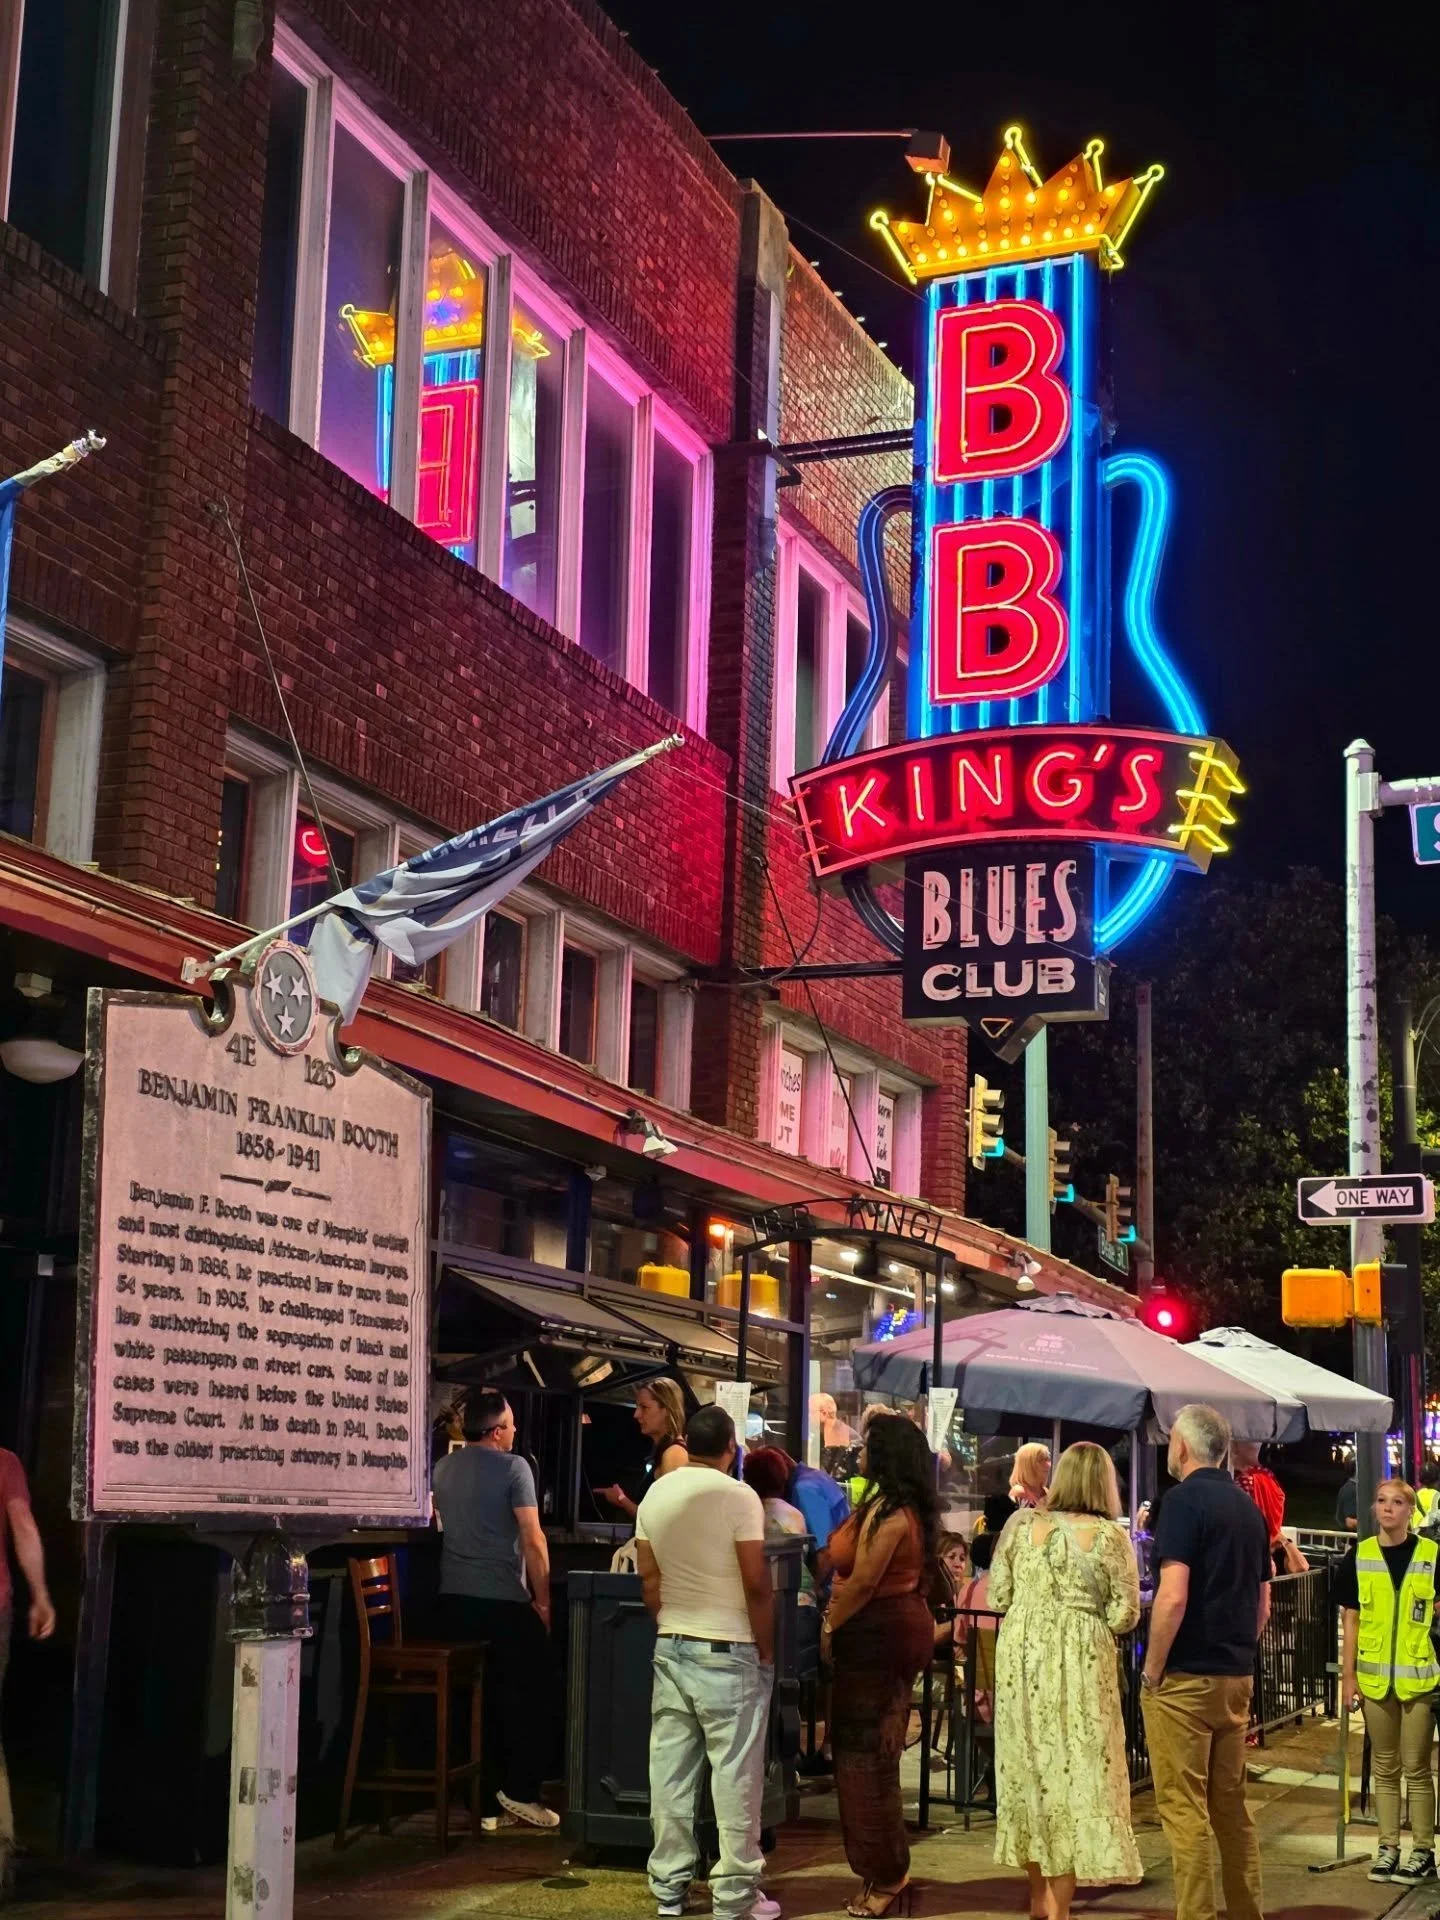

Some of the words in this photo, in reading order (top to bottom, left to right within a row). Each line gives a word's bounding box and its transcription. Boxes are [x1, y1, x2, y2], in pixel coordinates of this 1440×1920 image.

[934, 299, 1071, 485] B
[929, 517, 1069, 706] B
[832, 744, 1163, 846] KING'S
[922, 860, 1078, 949] BLUES
[921, 957, 1077, 1001] CLUB
[225, 1032, 256, 1067] 4E
[304, 1054, 336, 1089] 126
[138, 1067, 237, 1117] BENJAMIN
[248, 1096, 335, 1142] FRANKLIN
[342, 1119, 399, 1158] BOOTH
[236, 1131, 320, 1172] 1858-1941
[130, 1180, 194, 1209] Benjamin
[200, 1194, 210, 1213] F.
[215, 1198, 251, 1221] Booth
[256, 1211, 278, 1226] was
[281, 1216, 302, 1232] one
[307, 1218, 319, 1235] of
[1337, 1190, 1370, 1206] ONE
[1376, 1188, 1410, 1204] WAY
[118, 1215, 145, 1235] and
[149, 1221, 180, 1239] most
[116, 1273, 136, 1295] 54
[142, 1282, 184, 1300] years.
[197, 1287, 211, 1306] In
[259, 1296, 275, 1314] he
[279, 1300, 344, 1327] challenged
[117, 1243, 175, 1275] Starting
[180, 1253, 193, 1272] in
[236, 1263, 252, 1281] he
[257, 1269, 311, 1292] practiced
[315, 1277, 333, 1294] law
[338, 1280, 353, 1297] for
[356, 1287, 381, 1303] more
[386, 1289, 408, 1307] than
[116, 1305, 141, 1326] law
[149, 1313, 230, 1343] authorizing
[237, 1322, 258, 1340] the
[266, 1329, 333, 1350] segregation
[340, 1336, 351, 1353] of
[356, 1338, 384, 1356] black
[390, 1344, 408, 1360] and
[113, 1340, 155, 1360] white
[163, 1347, 237, 1371] passengers
[242, 1356, 259, 1371] on
[265, 1357, 301, 1375] street
[344, 1365, 372, 1383] Some
[377, 1368, 389, 1386] of
[394, 1369, 408, 1387] his
[113, 1375, 155, 1392] cases
[163, 1379, 199, 1396] were
[209, 1380, 249, 1401] heard
[257, 1384, 297, 1406] before
[305, 1389, 324, 1407] the
[332, 1391, 369, 1411] United
[375, 1395, 408, 1414] States
[113, 1401, 176, 1426] Supreme
[184, 1406, 226, 1429] Court.
[239, 1412, 254, 1430] At
[260, 1414, 279, 1432] his
[286, 1416, 320, 1435] death
[326, 1419, 338, 1437] in
[376, 1422, 409, 1441] Booth
[113, 1438, 139, 1456] was
[145, 1438, 169, 1456] the
[174, 1440, 213, 1460] oldest
[219, 1445, 284, 1467] practicing
[290, 1447, 341, 1469] attorney
[347, 1451, 357, 1466] in
